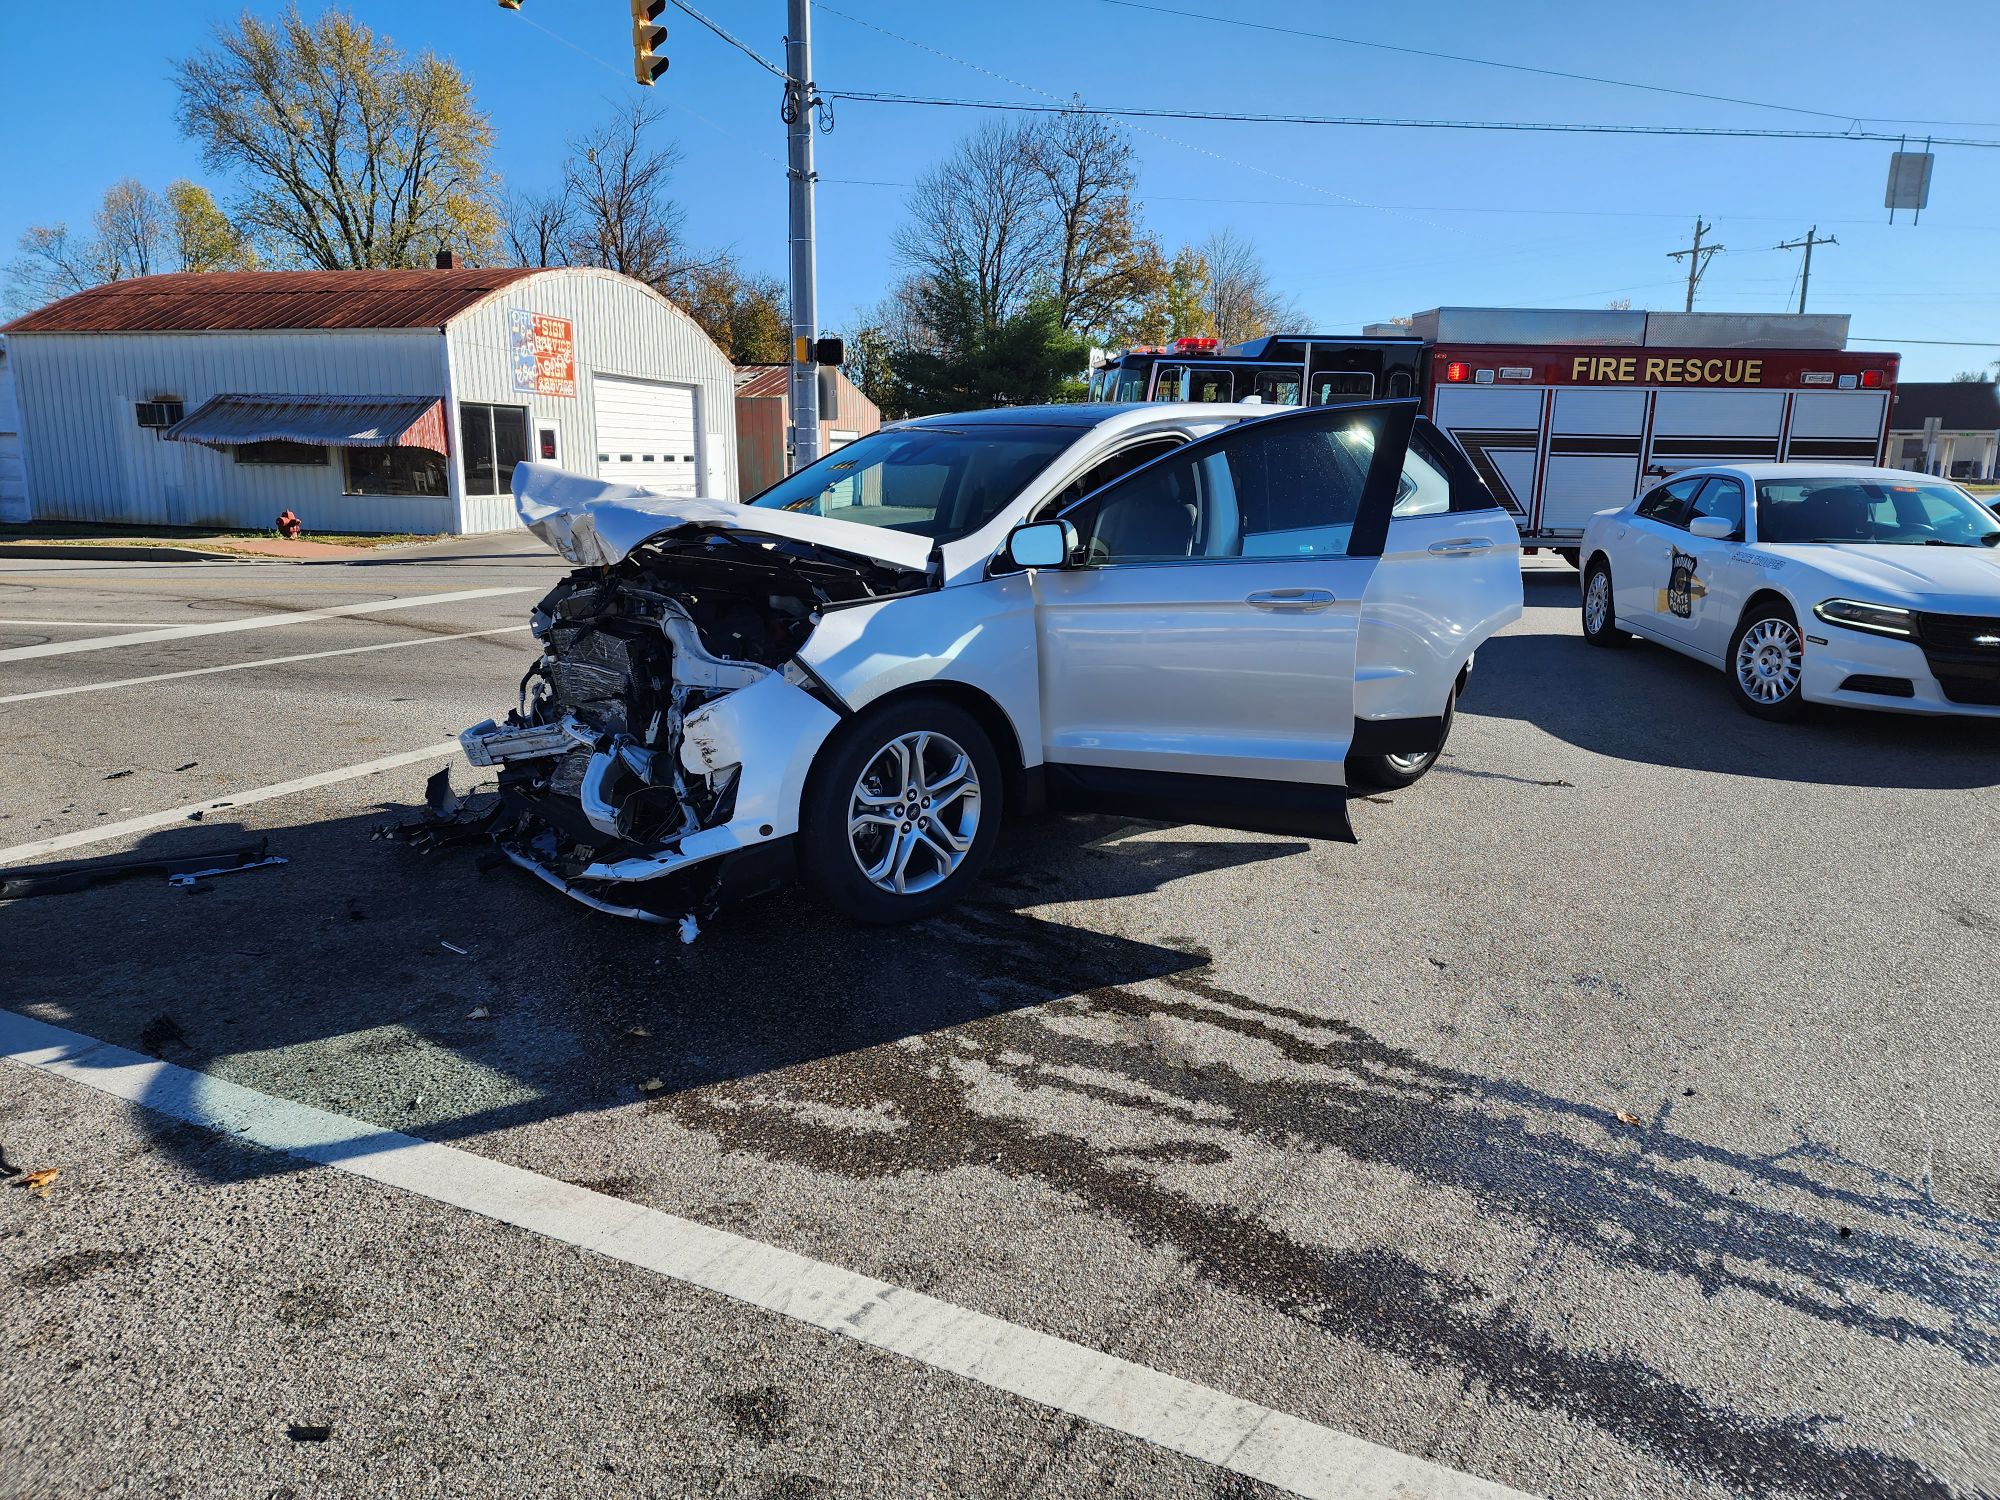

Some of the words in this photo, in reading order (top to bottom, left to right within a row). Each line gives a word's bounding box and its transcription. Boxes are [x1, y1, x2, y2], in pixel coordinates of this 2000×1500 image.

[541, 320, 565, 339] SIGN
[1571, 357, 1637, 381] FIRE
[1645, 358, 1763, 383] RESCUE
[1673, 556, 1695, 573] INDIANA
[1669, 588, 1689, 604] STATE
[1669, 598, 1690, 615] POLICE
